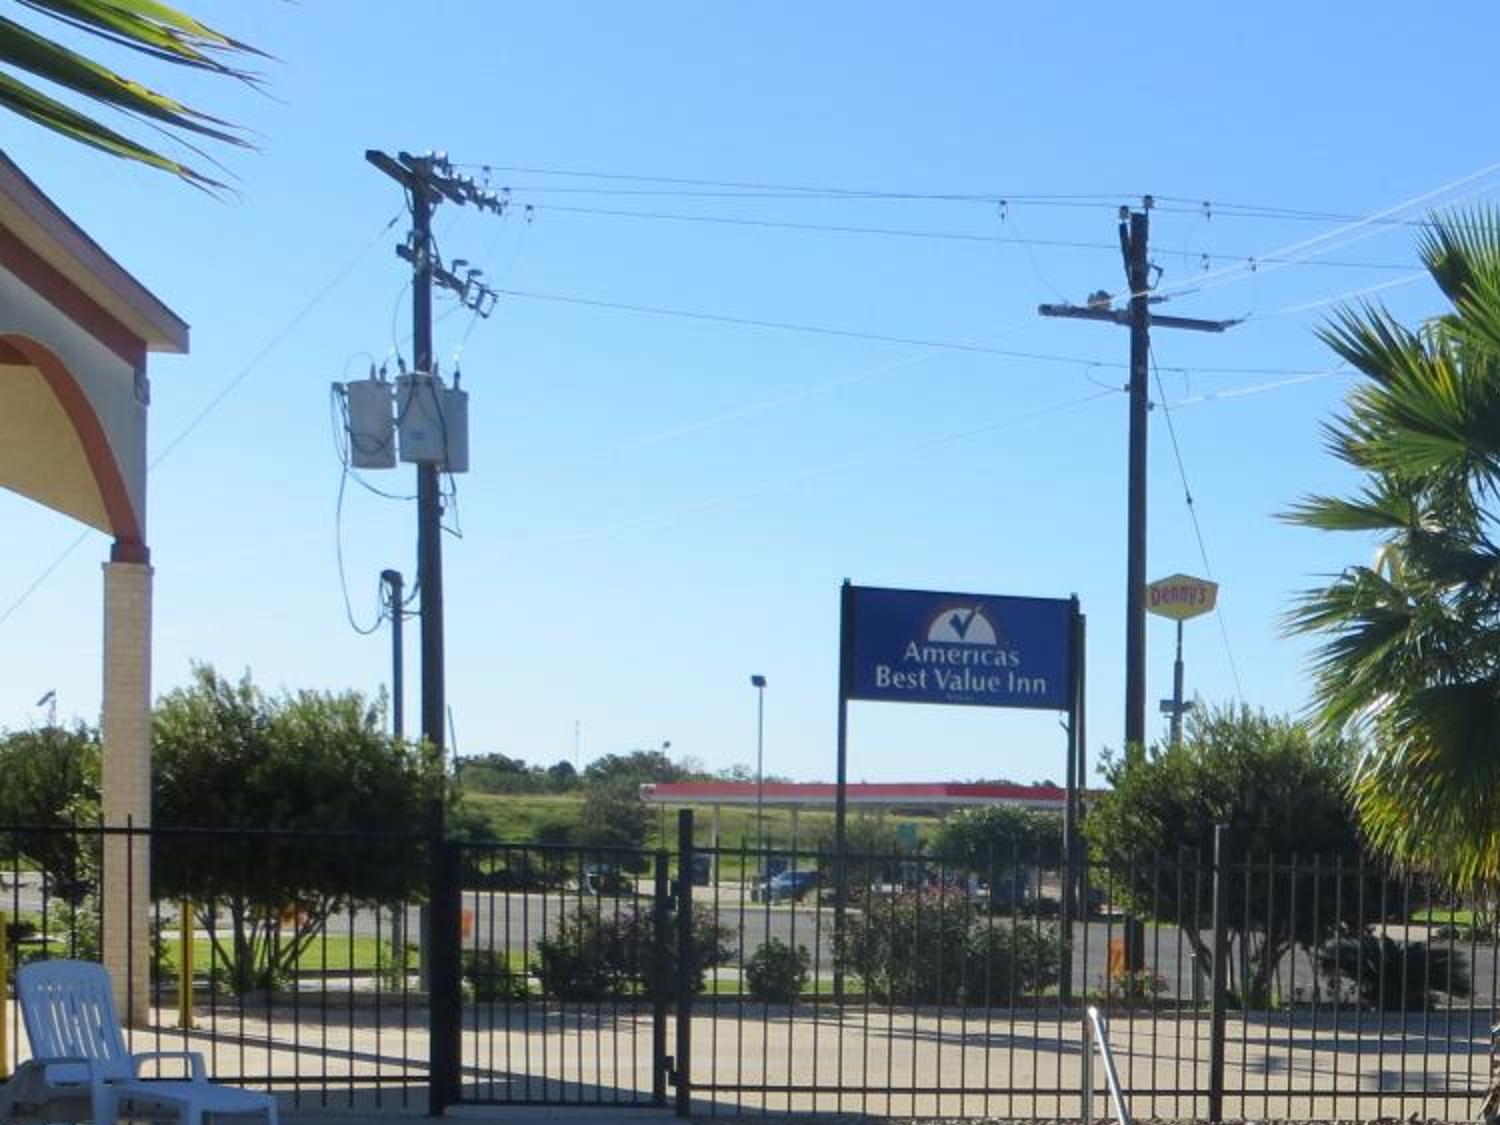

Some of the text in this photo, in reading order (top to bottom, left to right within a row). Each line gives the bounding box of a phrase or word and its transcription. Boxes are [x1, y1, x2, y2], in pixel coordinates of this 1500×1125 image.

[875, 664, 1046, 694] Best Value Inn
